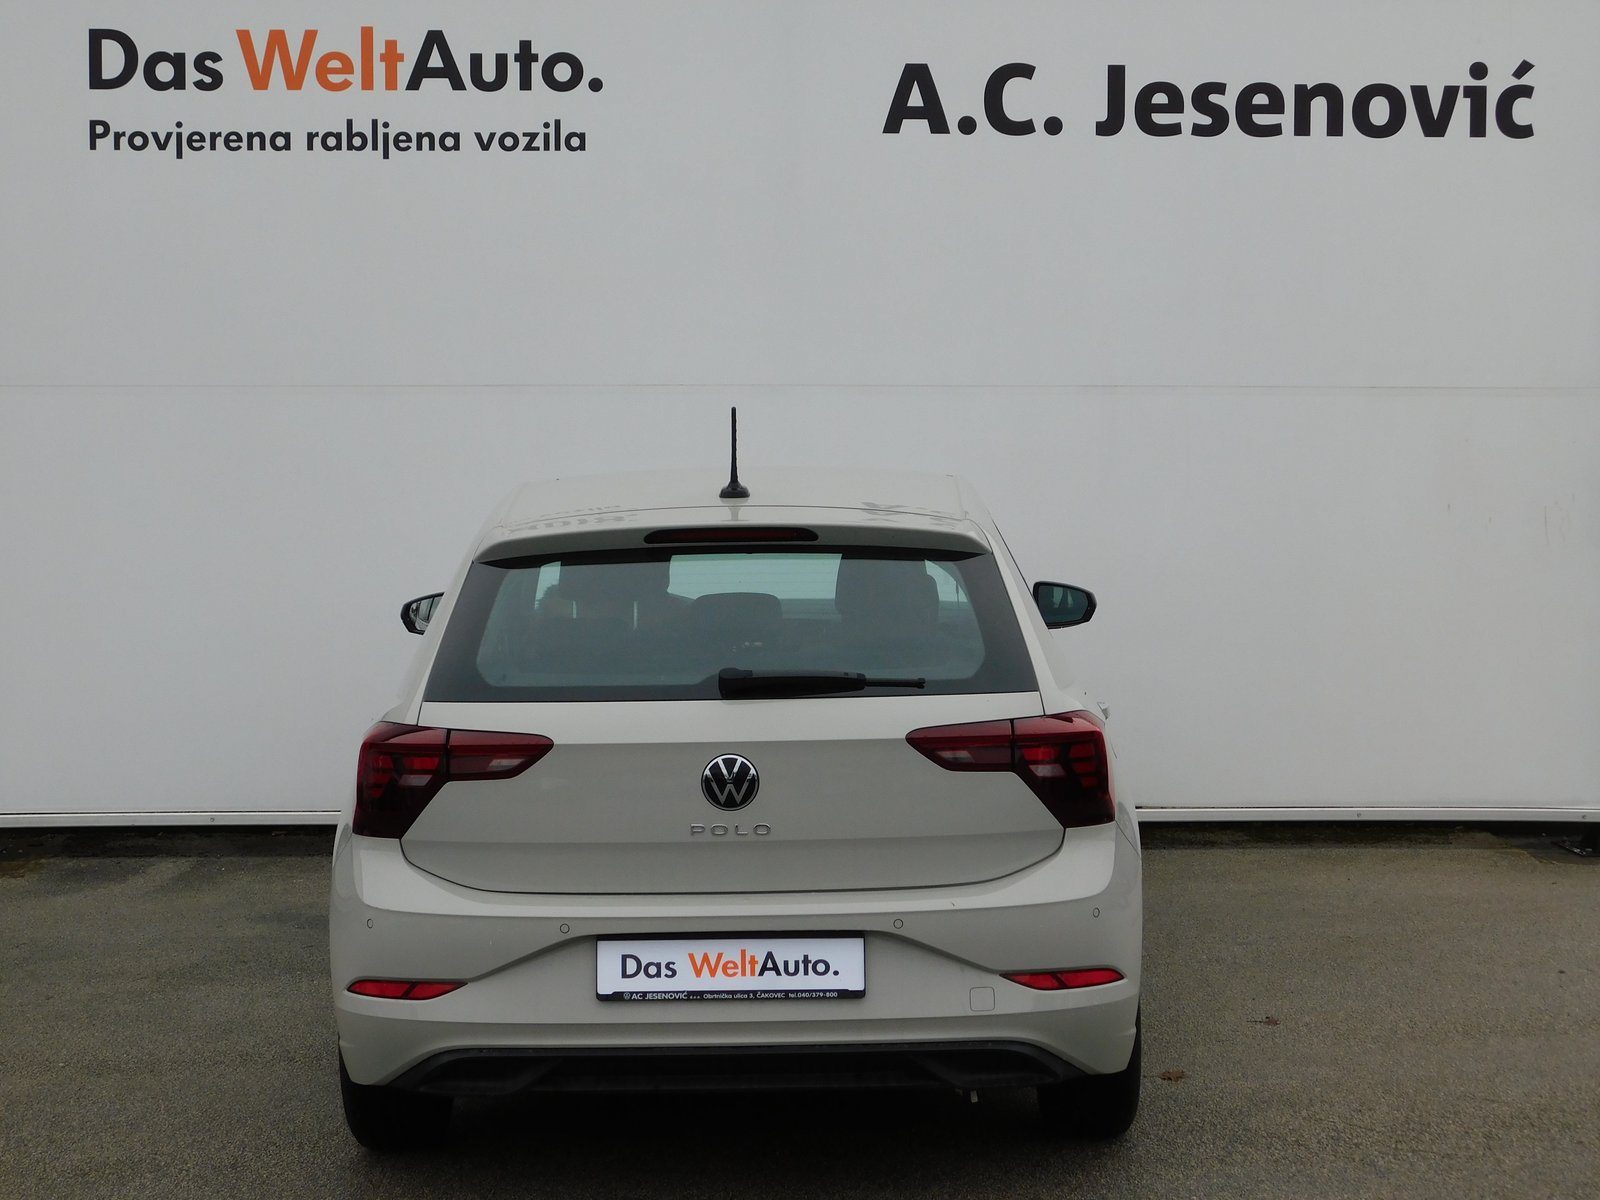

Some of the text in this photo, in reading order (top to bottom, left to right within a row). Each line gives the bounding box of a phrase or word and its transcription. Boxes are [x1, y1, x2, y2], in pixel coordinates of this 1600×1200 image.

[89, 26, 603, 92] Das WeltAuto.
[882, 59, 1535, 139] A.C. Jesenović
[89, 119, 586, 159] Provjerena rabljena vozila
[690, 823, 771, 836] POLO
[621, 949, 840, 979] Das WeltAuto.
[645, 991, 688, 1000] JESENOVIĆ
[756, 991, 786, 999] ČAKOVEC
